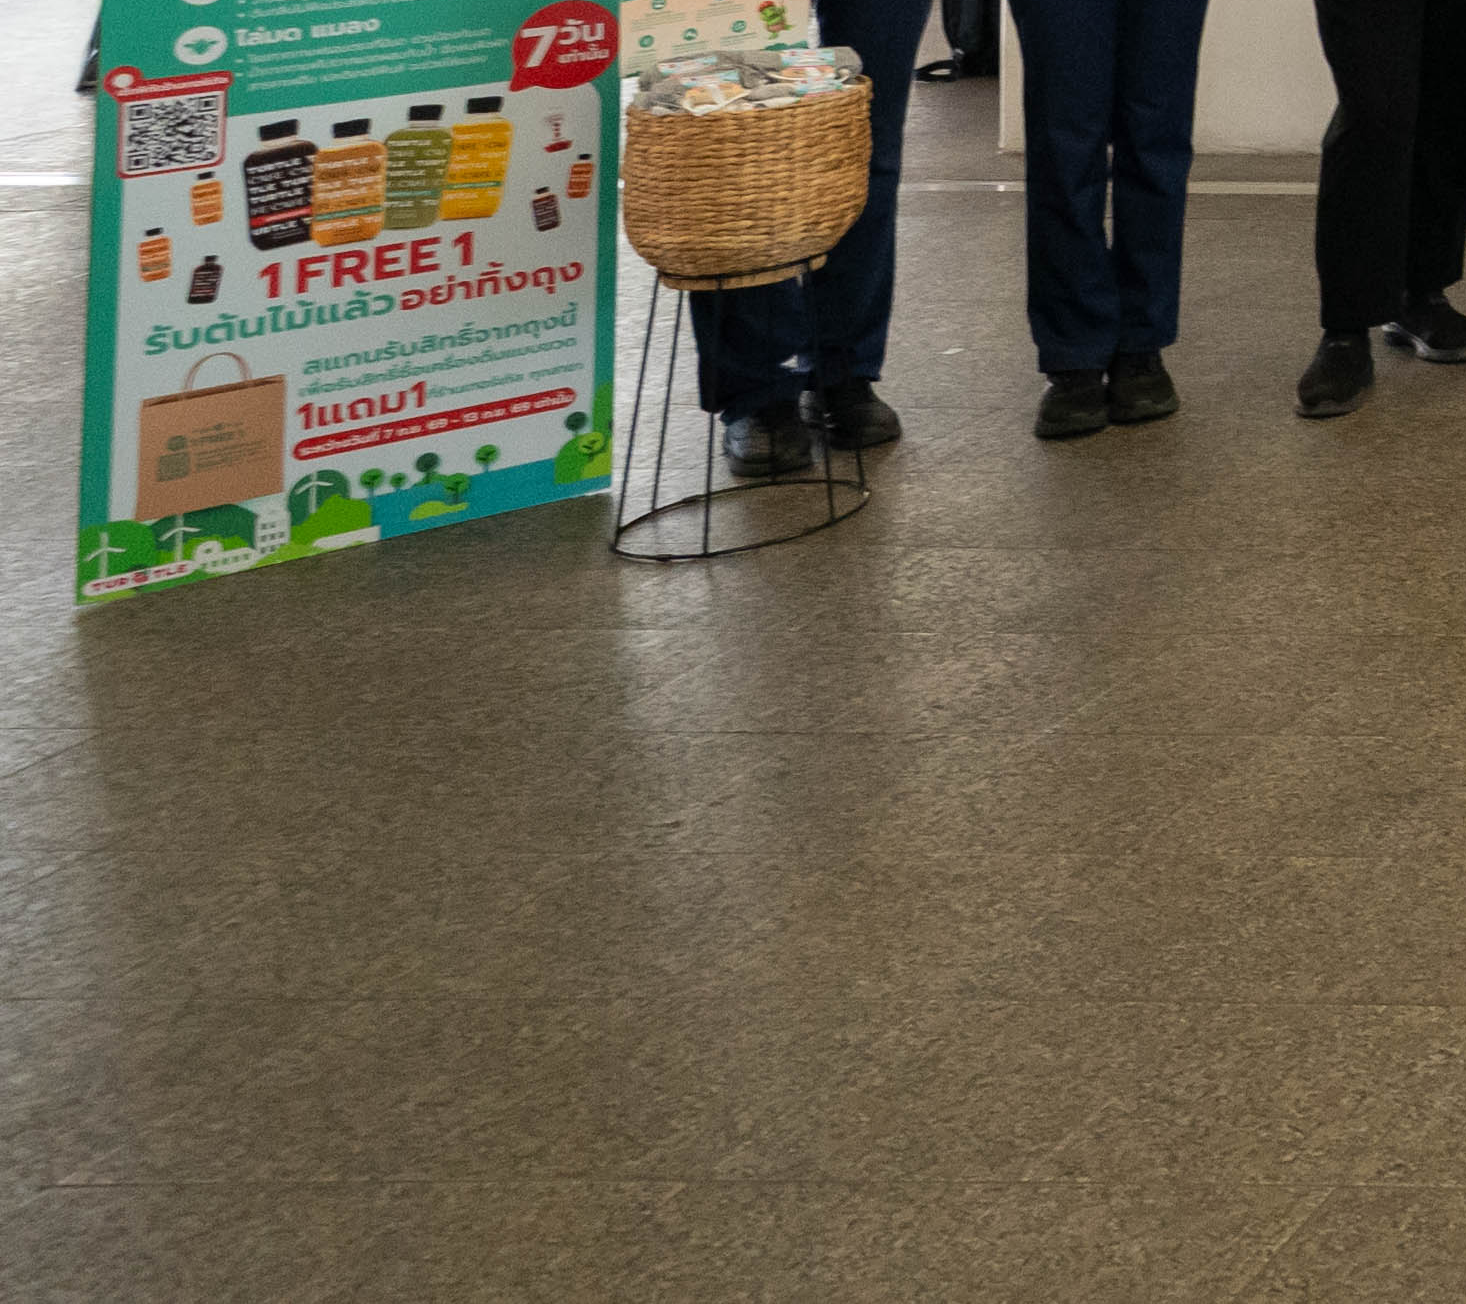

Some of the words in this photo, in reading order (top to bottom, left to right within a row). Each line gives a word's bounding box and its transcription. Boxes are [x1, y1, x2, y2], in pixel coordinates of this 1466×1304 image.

[521, 25, 558, 69] 7
[558, 18, 605, 45] วัน
[258, 262, 282, 299] 1
[295, 237, 442, 294] FREE
[452, 231, 475, 267] 1
